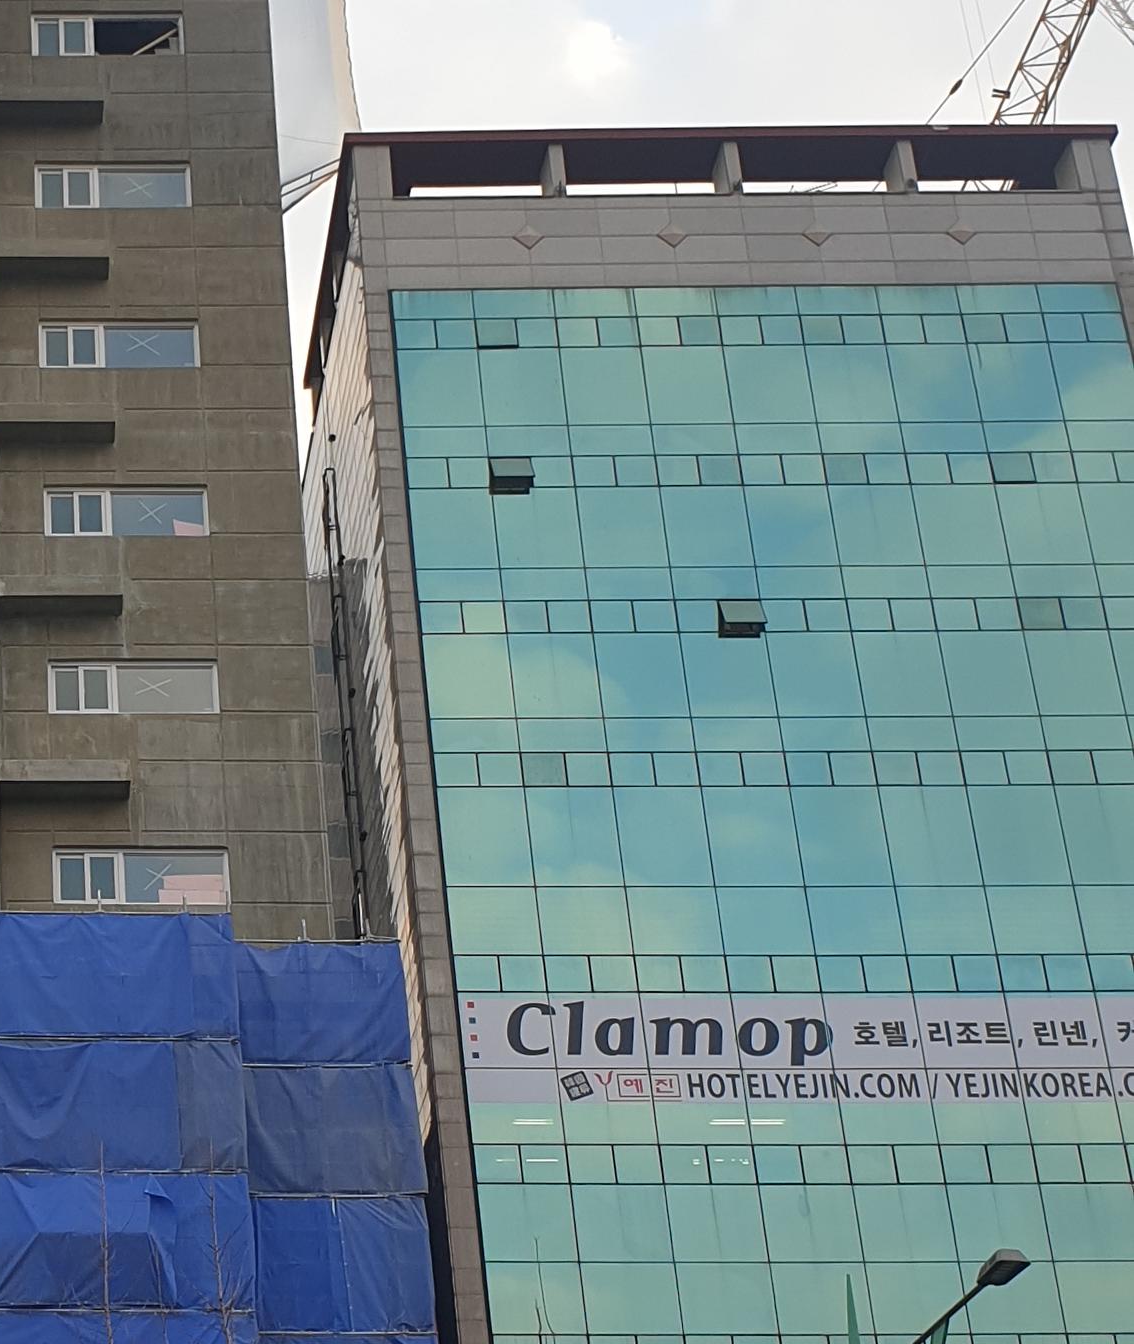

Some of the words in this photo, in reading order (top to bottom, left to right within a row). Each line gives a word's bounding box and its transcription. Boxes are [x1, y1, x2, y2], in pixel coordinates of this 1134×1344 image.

[506, 1001, 834, 1068] Clamop
[853, 1018, 919, 1049] 호텔,
[928, 1019, 1023, 1048] 리조트,
[1032, 1020, 1098, 1048] 린넨,
[687, 1073, 922, 1101] HOTELYEJIN.COM
